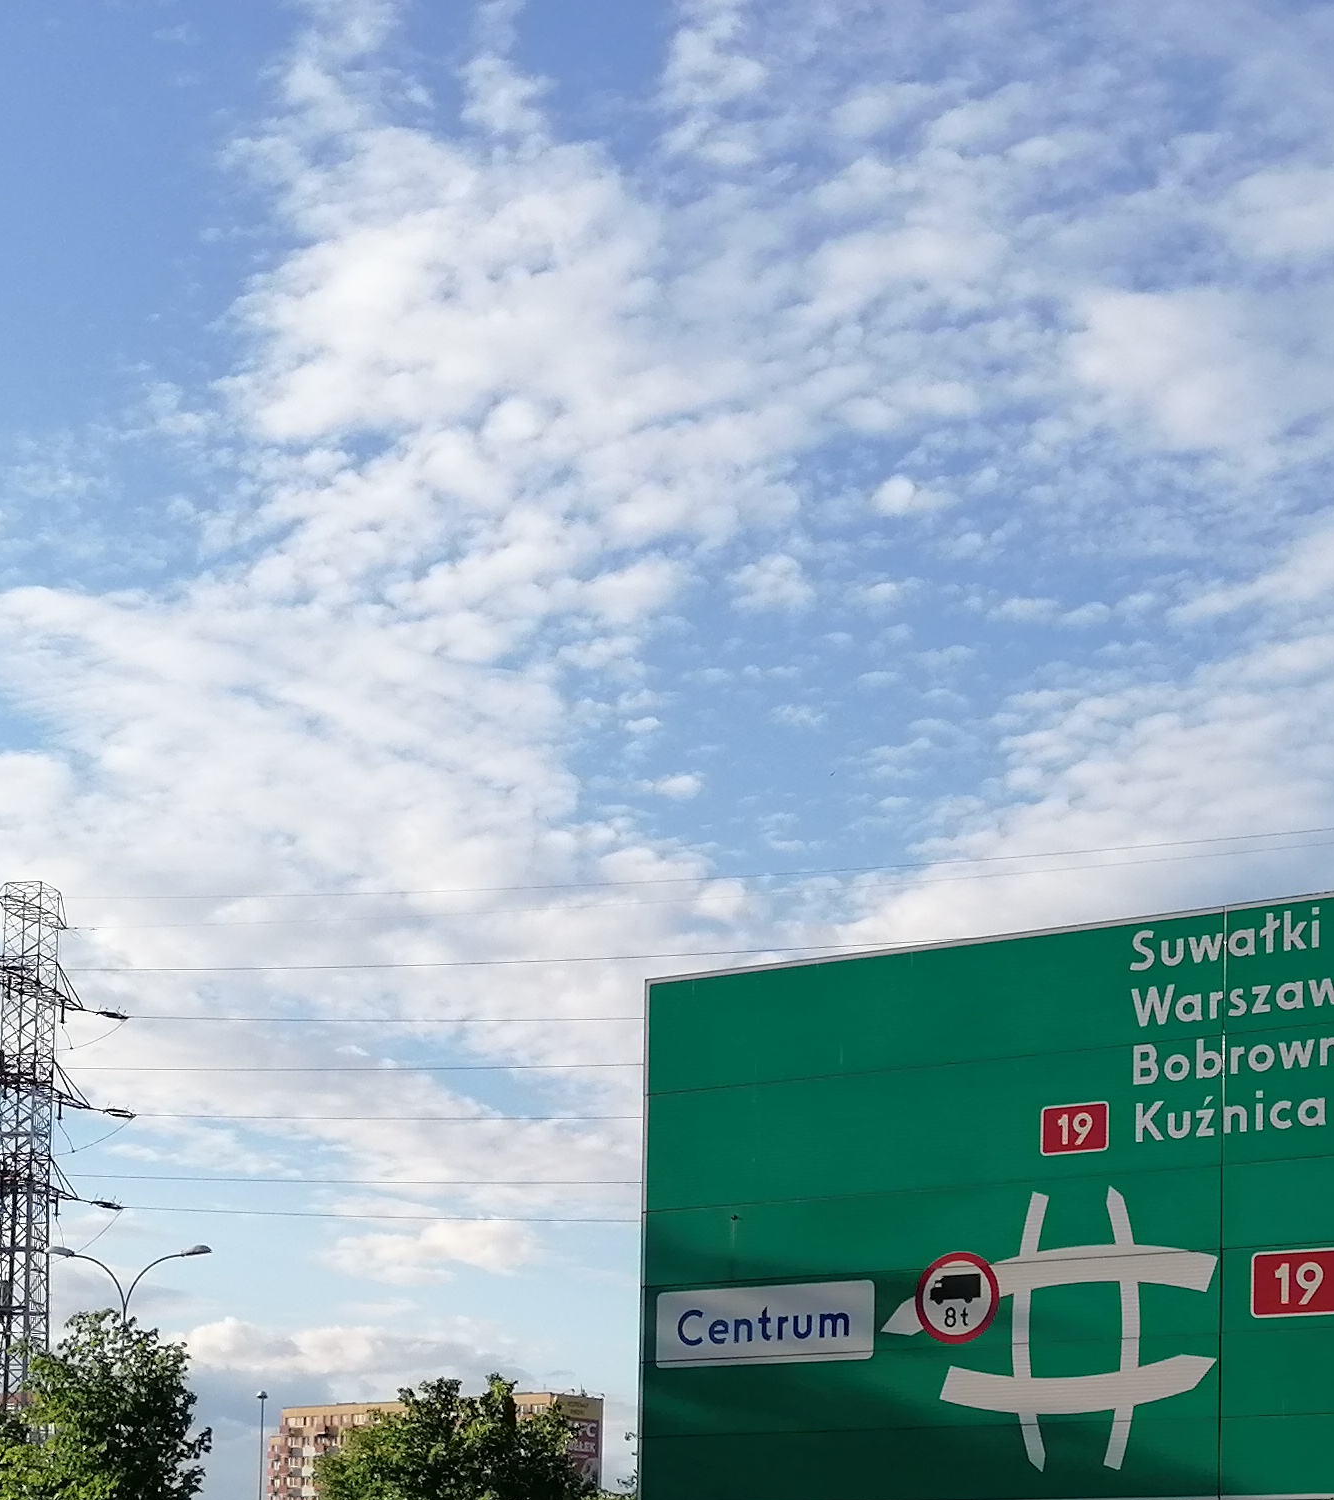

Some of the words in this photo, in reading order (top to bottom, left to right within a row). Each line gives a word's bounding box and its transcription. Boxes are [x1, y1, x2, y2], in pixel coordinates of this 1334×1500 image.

[1129, 906, 1321, 972] Suwałki
[1057, 1112, 1094, 1146] 19
[1134, 1090, 1327, 1143] Kuźnica
[1274, 1261, 1324, 1305] 19
[677, 1306, 850, 1346] Centrum
